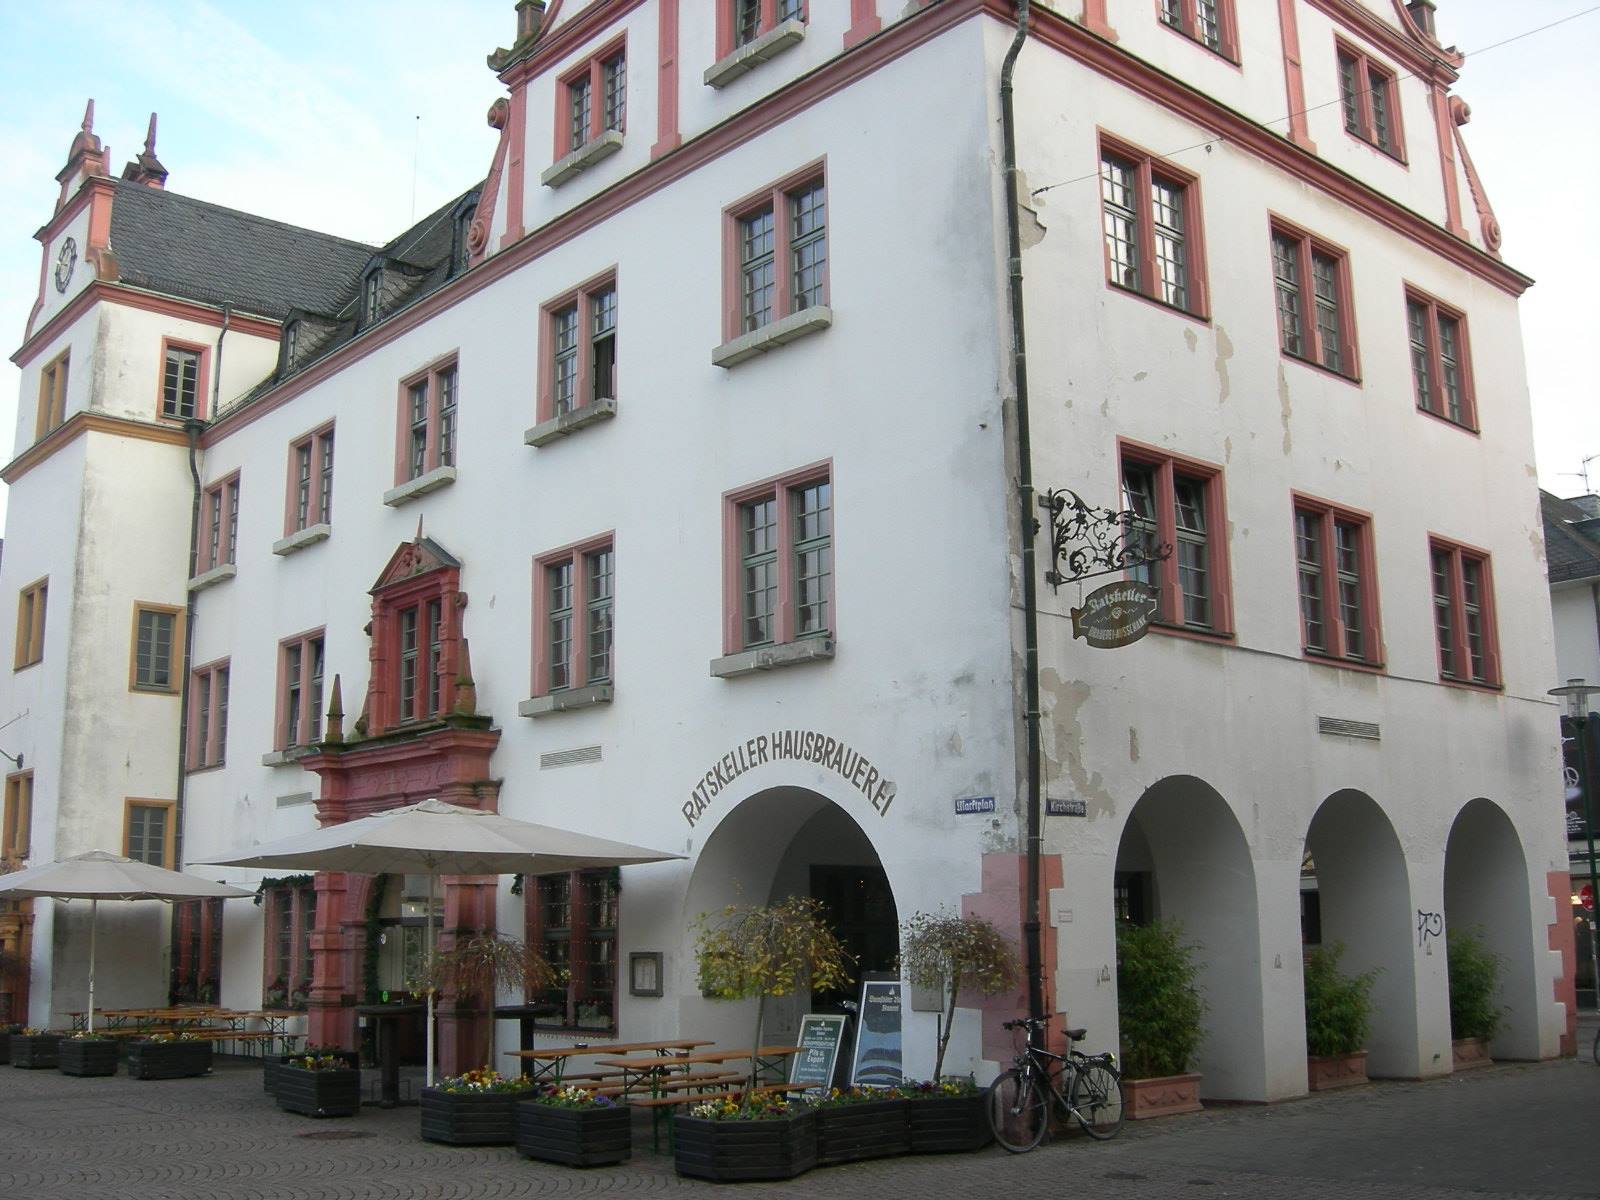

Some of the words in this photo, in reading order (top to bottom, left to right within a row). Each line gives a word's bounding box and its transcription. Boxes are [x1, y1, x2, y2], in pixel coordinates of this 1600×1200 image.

[1088, 588, 1147, 615] Ratskeller
[681, 735, 768, 828] RATSKELLER
[772, 730, 896, 818] HAUSBRAUEREI
